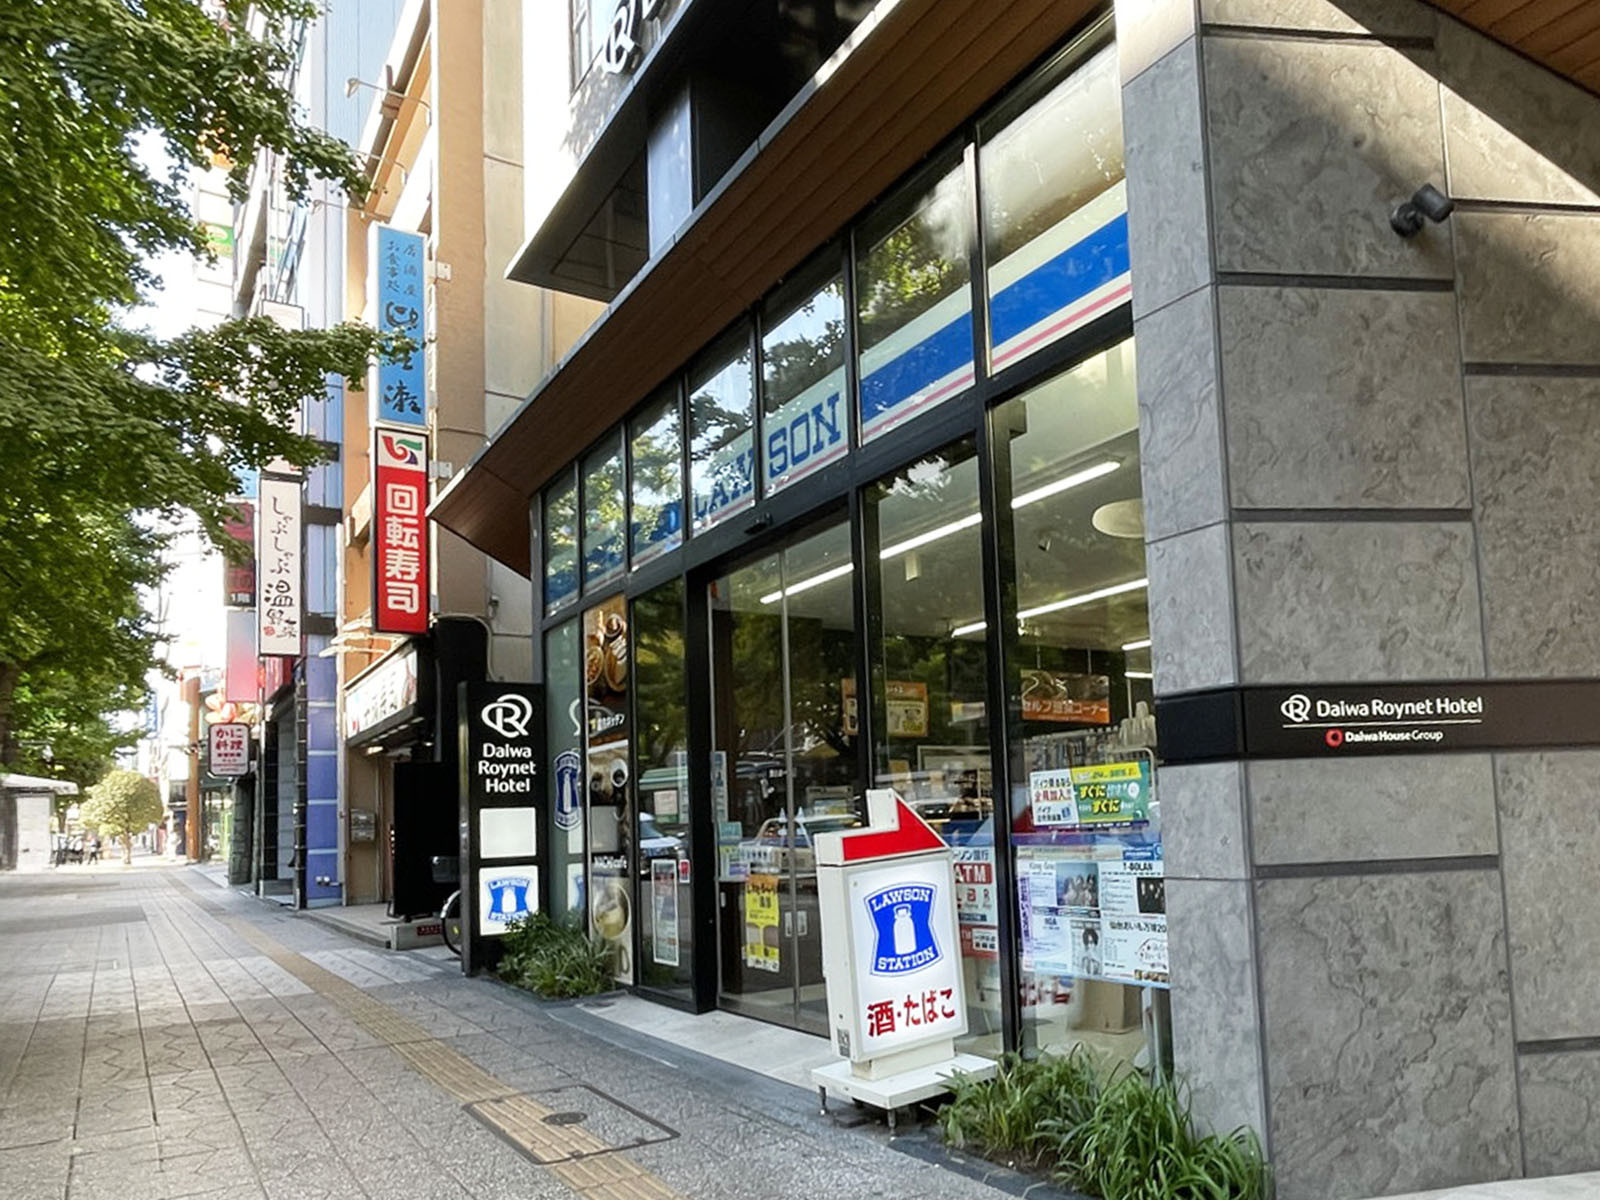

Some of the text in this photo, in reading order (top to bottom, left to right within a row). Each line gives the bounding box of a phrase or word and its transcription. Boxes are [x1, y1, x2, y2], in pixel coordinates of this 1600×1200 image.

[386, 483, 421, 614] 回転寿司
[1316, 696, 1483, 720] Daiwa Roynet Hotel
[215, 727, 244, 738] かに
[1345, 729, 1444, 742] Daiwa House Group
[482, 742, 533, 758] Daiwa
[478, 760, 537, 779] Roynet
[485, 778, 531, 793] Hotel
[1079, 783, 1107, 800] すぐに
[1092, 799, 1121, 815] すぐに
[954, 864, 987, 883] ATM
[869, 887, 932, 911] LAWSON
[876, 947, 936, 970] STATION
[867, 988, 956, 1037] 酒・たばこ
